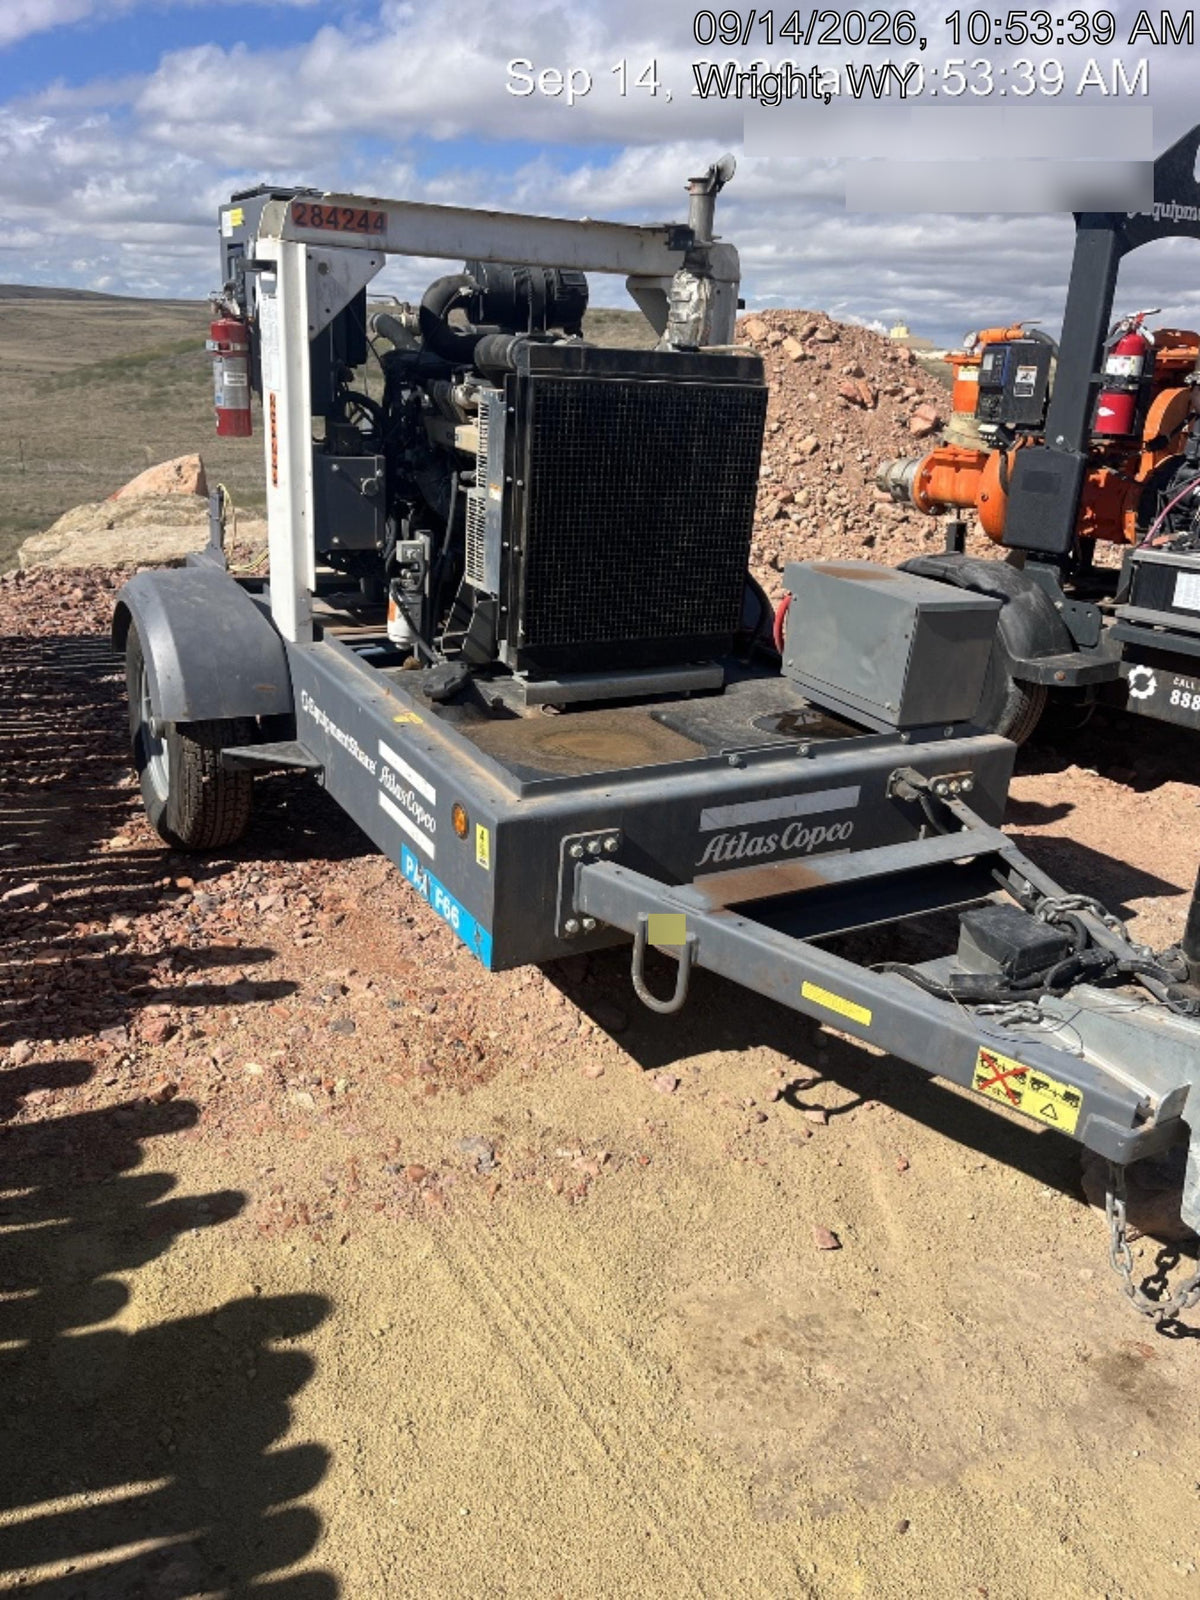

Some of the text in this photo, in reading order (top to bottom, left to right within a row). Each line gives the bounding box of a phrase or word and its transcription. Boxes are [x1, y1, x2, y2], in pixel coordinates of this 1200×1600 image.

[293, 202, 387, 232] 284244
[1142, 199, 1200, 223] quipm
[694, 821, 855, 866] Atlas Copco
